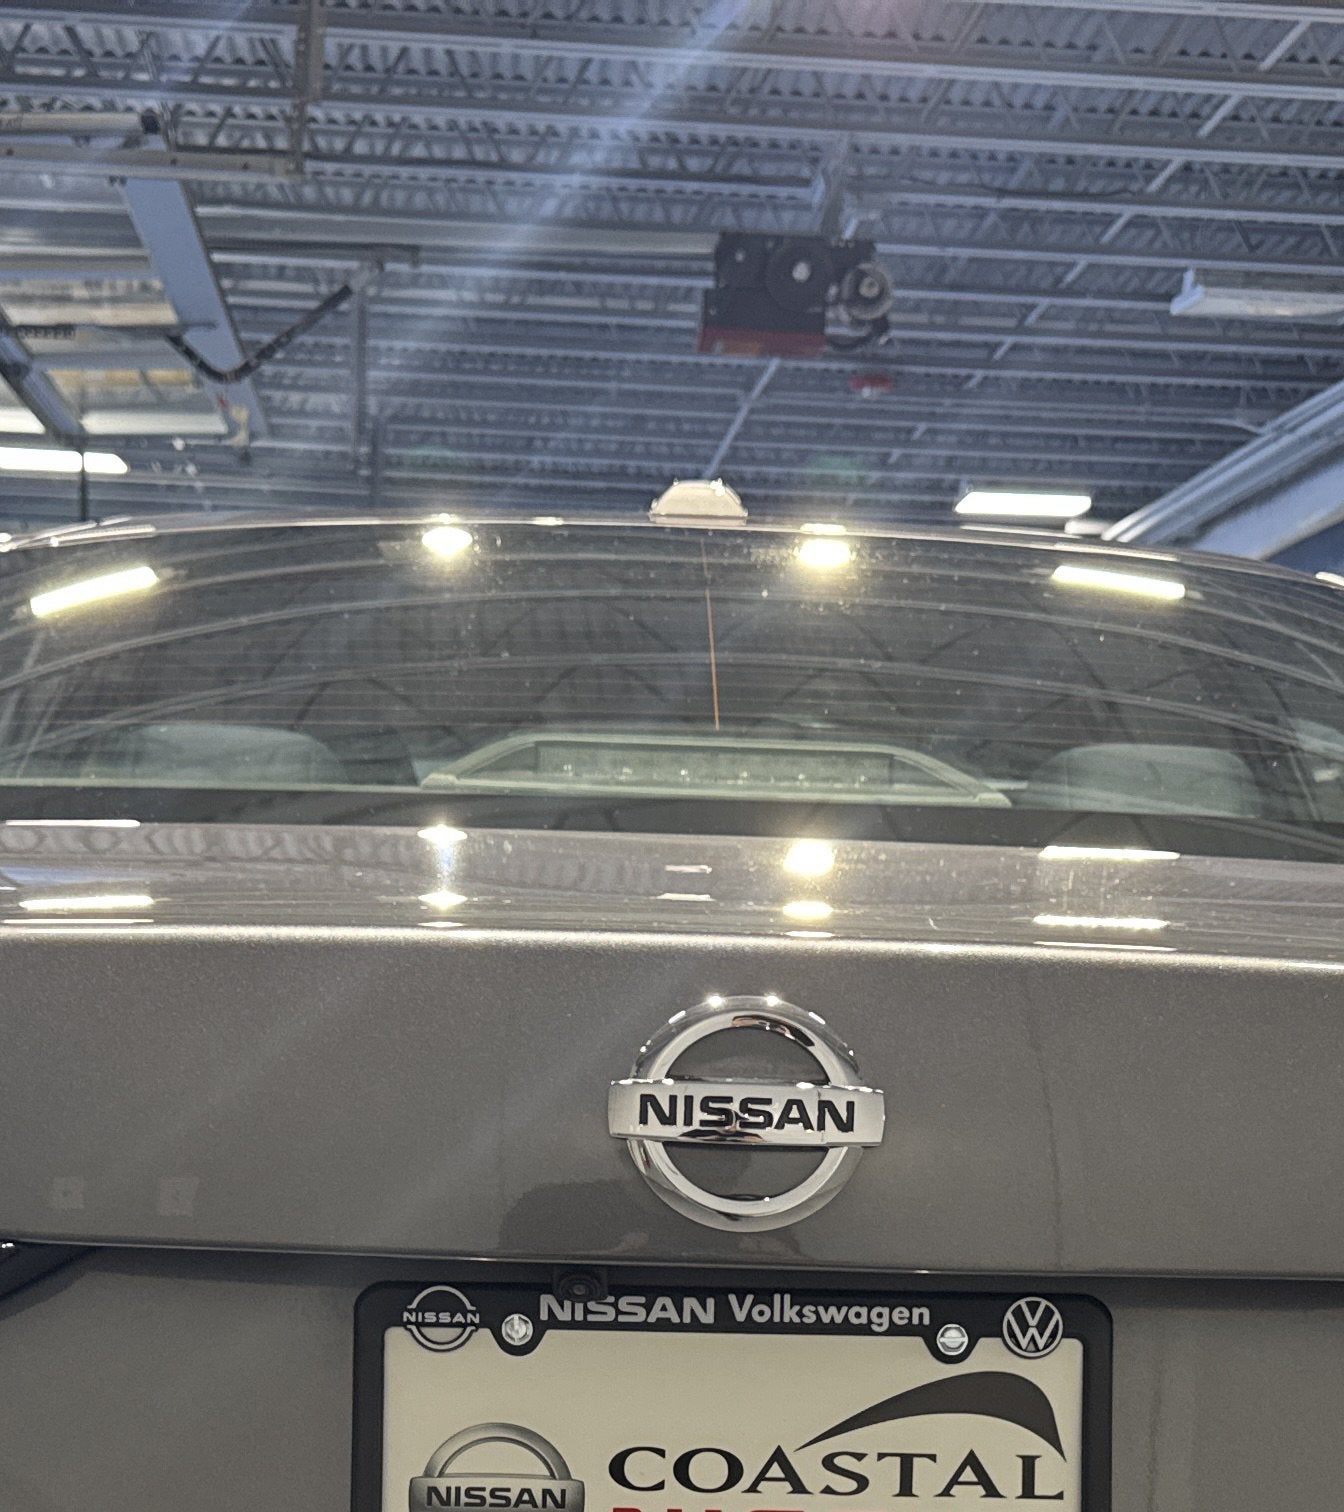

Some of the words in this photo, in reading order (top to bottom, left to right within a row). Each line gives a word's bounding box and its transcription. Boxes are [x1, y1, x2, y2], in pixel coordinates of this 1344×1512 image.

[638, 1093, 855, 1133] NISSAN
[402, 1311, 480, 1324] NISSAN
[539, 1294, 716, 1325] NISSAN
[728, 1293, 930, 1332] Volkswagen
[608, 1445, 1065, 1501] COASTAL
[426, 1485, 567, 1510] NISSAN
